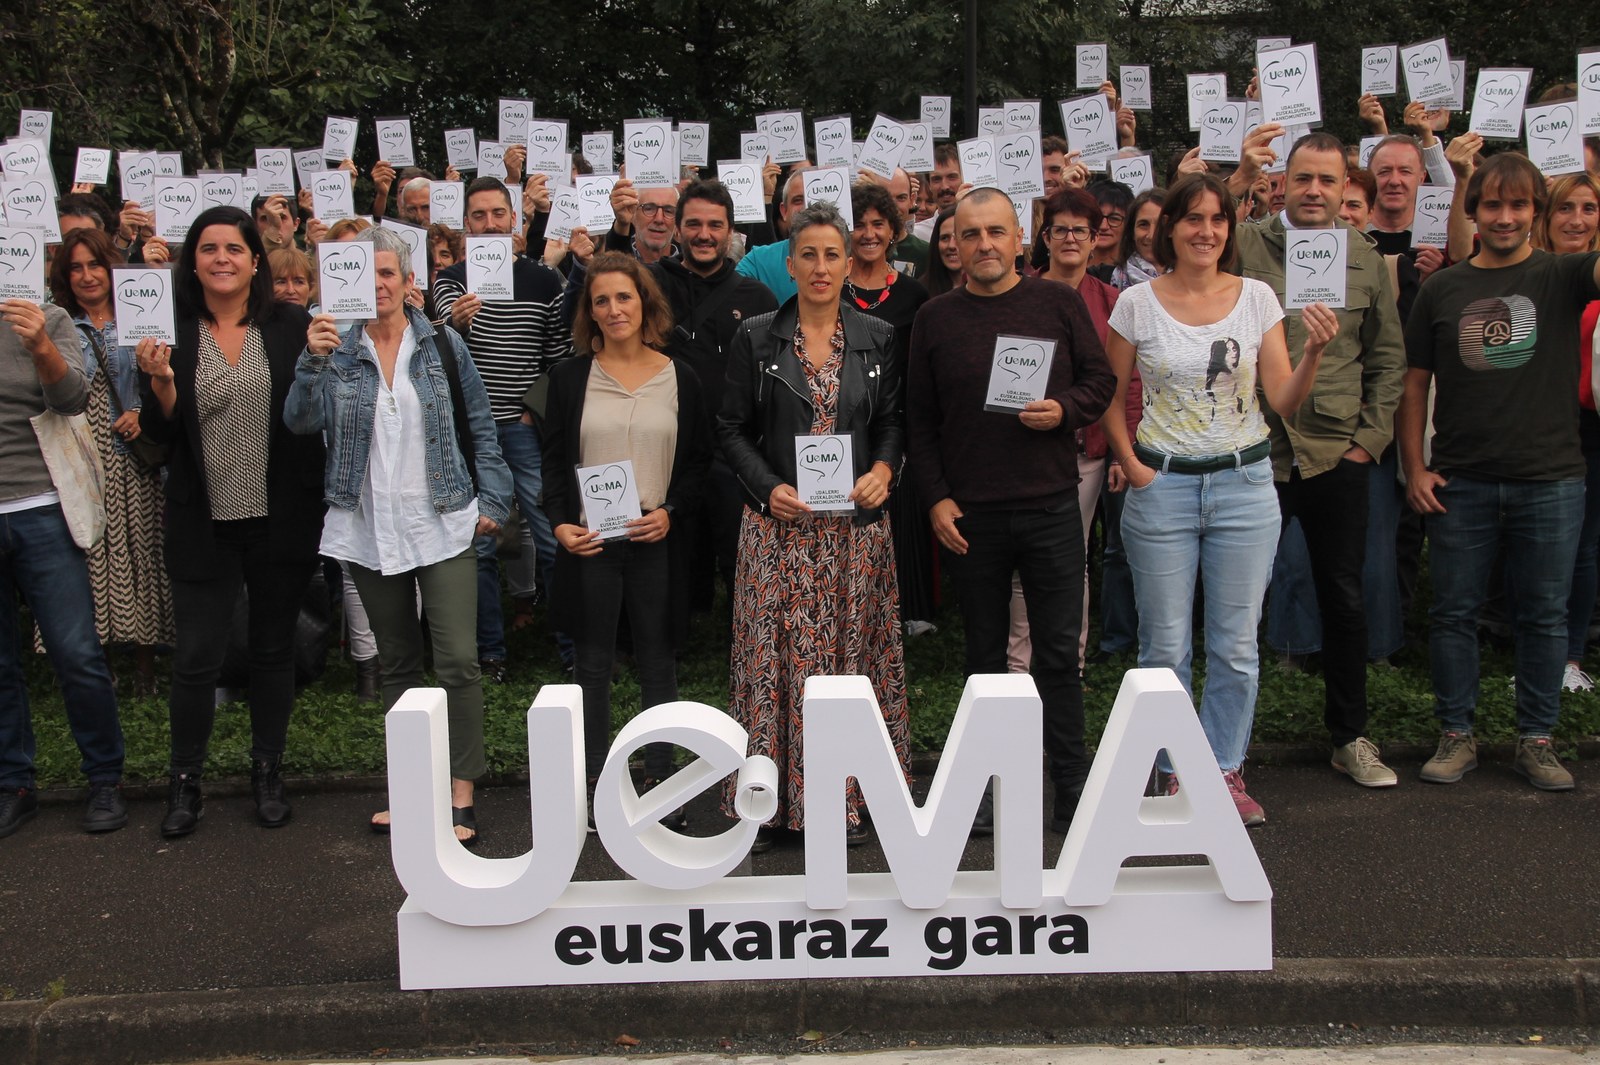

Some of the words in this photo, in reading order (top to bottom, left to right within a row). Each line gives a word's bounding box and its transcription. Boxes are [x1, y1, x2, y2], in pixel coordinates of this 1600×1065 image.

[1412, 56, 1438, 68] UeMA
[1269, 67, 1302, 80] UeMA
[1281, 103, 1304, 111] UDALERRI
[1536, 121, 1568, 133] UeMA
[1004, 150, 1030, 160] UeMA
[1297, 249, 1331, 260] UeMA
[329, 262, 361, 271] UeMA
[125, 289, 157, 297] UeMA
[1005, 356, 1037, 368] UeMA
[806, 454, 838, 463] UeMA
[590, 480, 622, 493] UeMA
[386, 669, 1273, 926] UeMA
[555, 909, 889, 964] euskaraz
[924, 913, 1090, 970] gara
